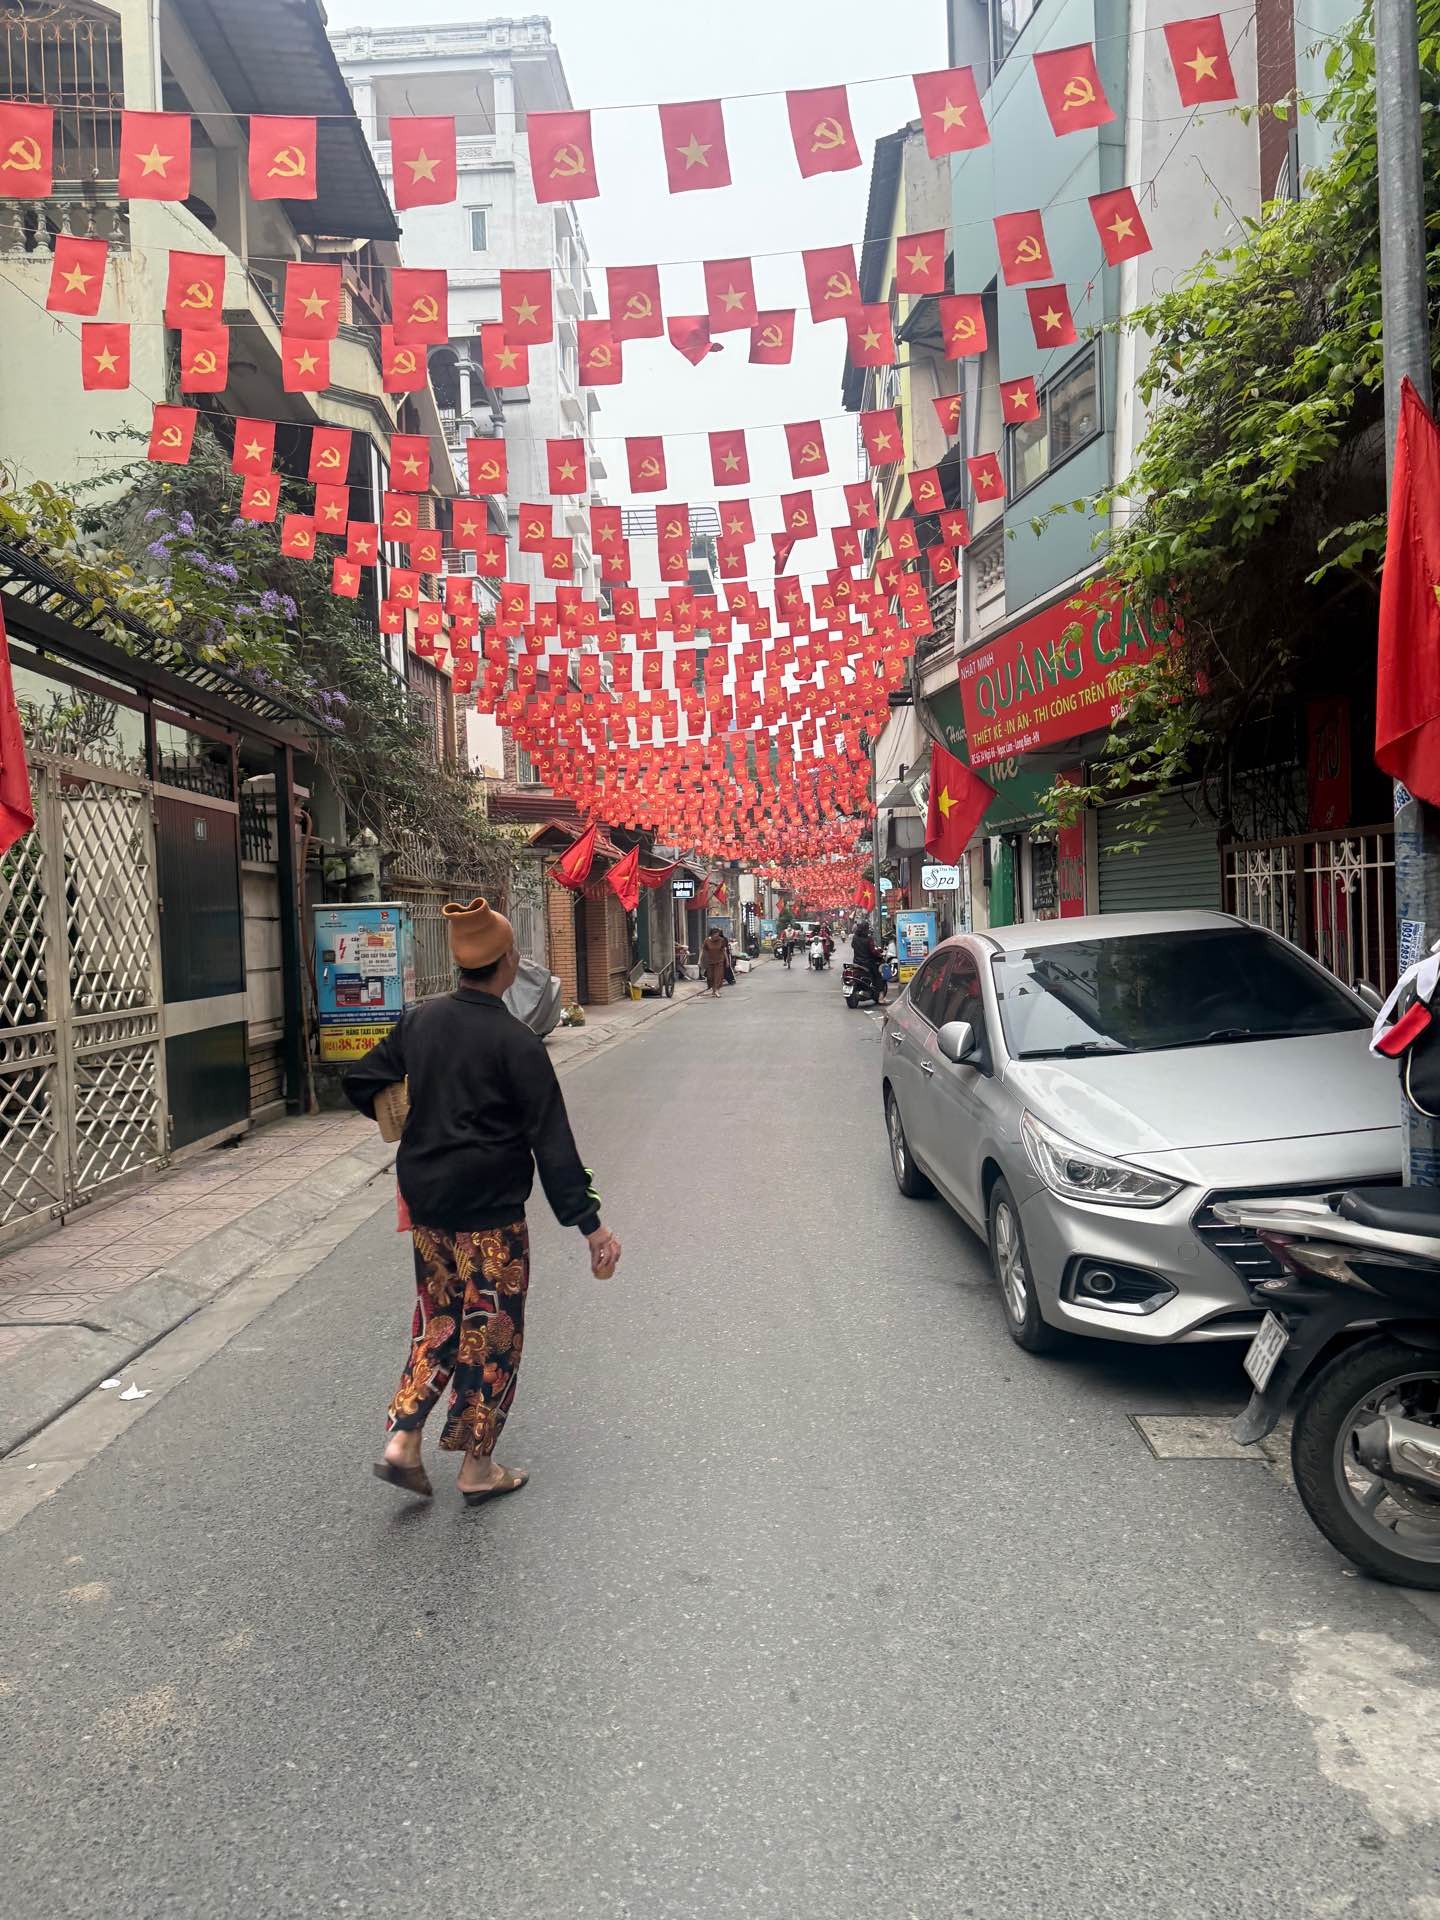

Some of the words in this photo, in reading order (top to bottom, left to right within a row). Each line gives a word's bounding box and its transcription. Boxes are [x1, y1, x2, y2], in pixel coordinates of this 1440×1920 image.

[976, 652, 995, 672] MINH
[976, 634, 1083, 719] QUẢNG
[1033, 705, 1049, 724] THI
[1050, 696, 1078, 718] CÔNG
[1078, 681, 1106, 707] TRÊN
[924, 868, 954, 889] Spa
